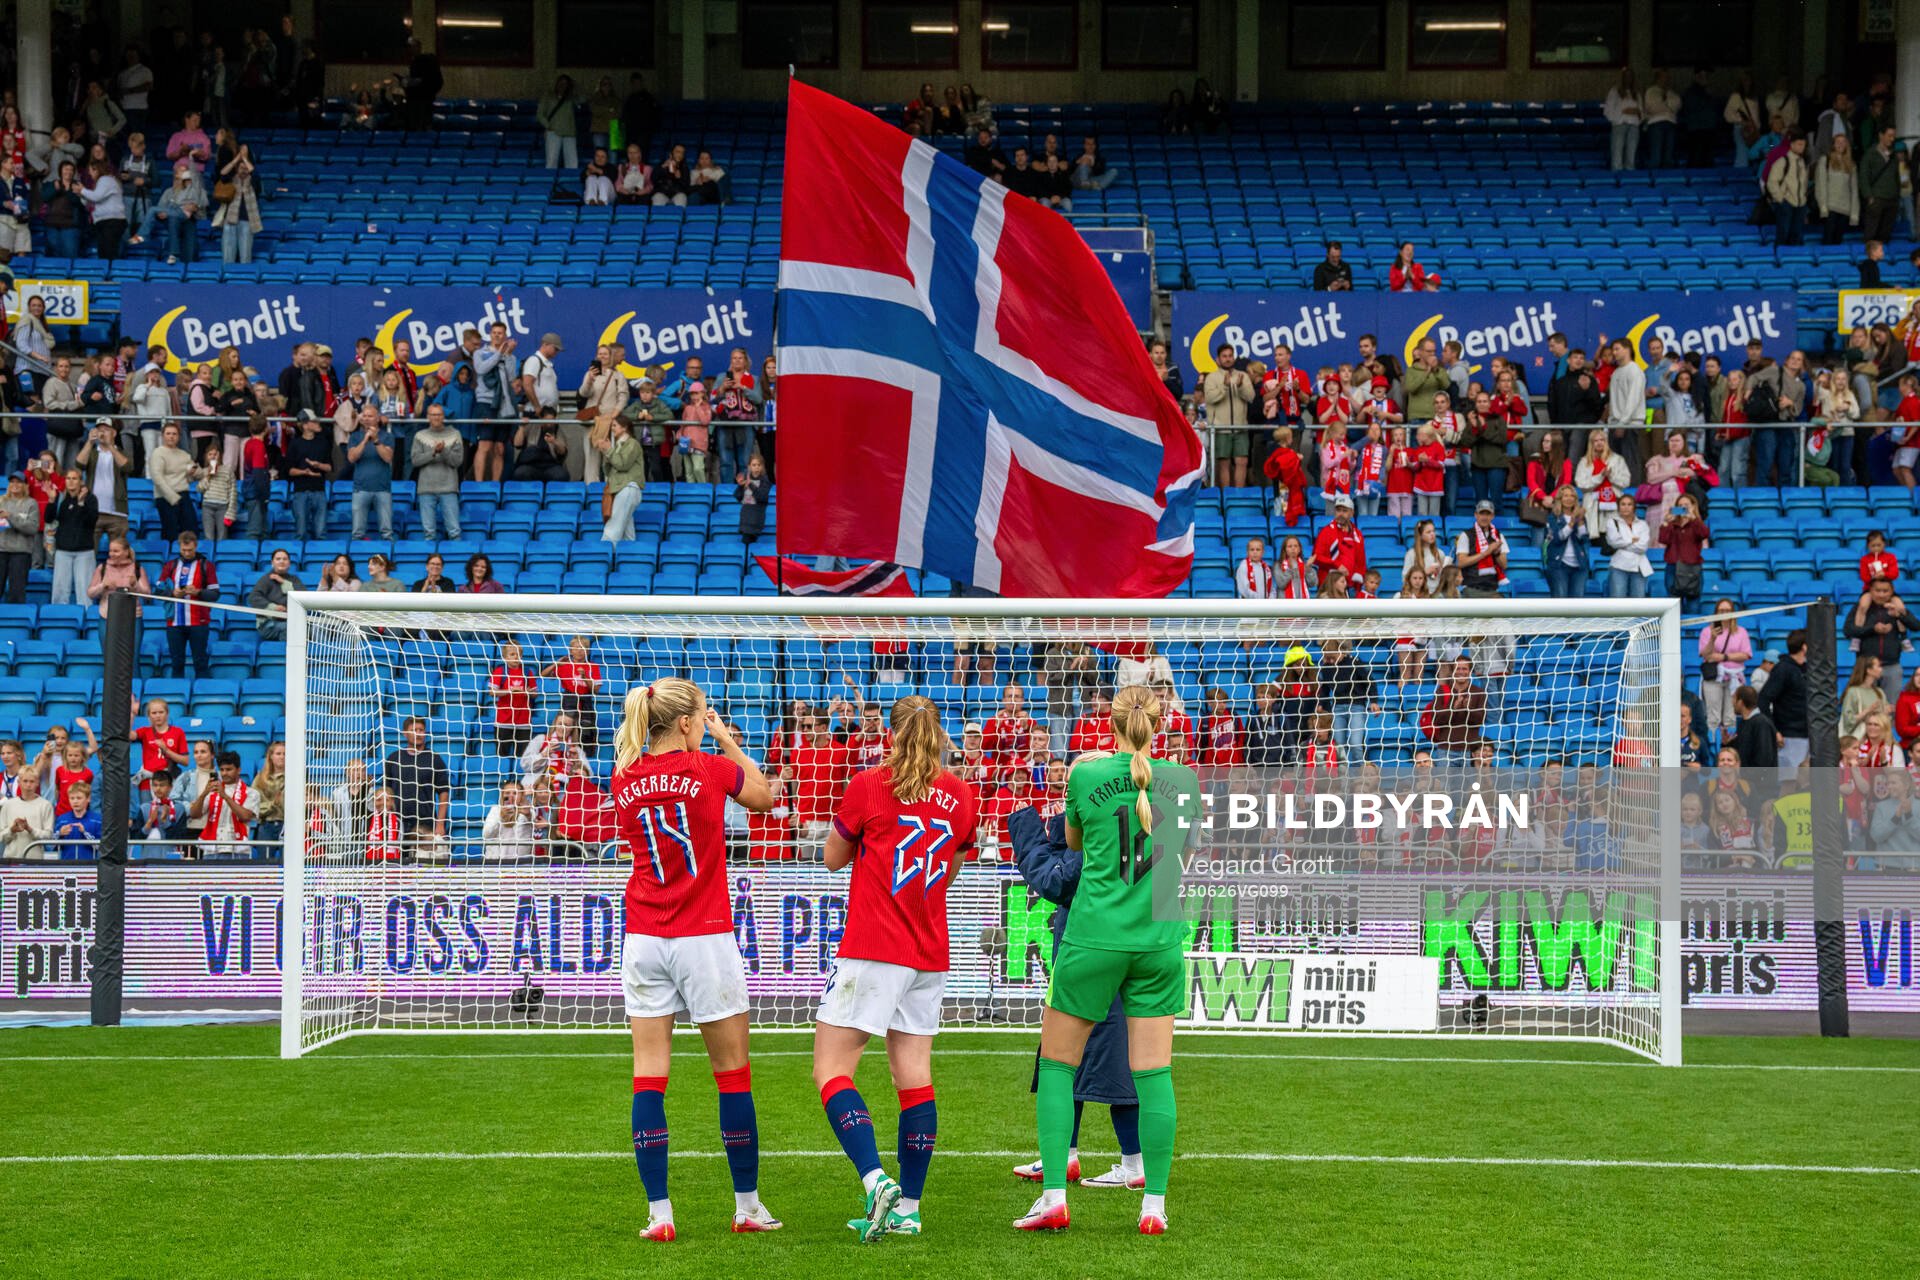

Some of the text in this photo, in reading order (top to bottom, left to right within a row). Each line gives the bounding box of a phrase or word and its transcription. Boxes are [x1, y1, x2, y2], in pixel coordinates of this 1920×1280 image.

[182, 295, 305, 356] Bendit
[631, 300, 753, 362] Bendit
[1224, 301, 1346, 360] Bendit
[617, 774, 702, 809] HEGERBERG
[636, 801, 698, 884] 14
[891, 814, 954, 900] 22
[17, 878, 98, 930] min
[200, 895, 252, 975] VI
[386, 895, 490, 974] OSS
[1424, 888, 1657, 988] KIWI
[1858, 907, 1913, 988] VI
[1303, 961, 1377, 992] mini
[1681, 940, 1777, 1005] pris
[1301, 993, 1366, 1030] pris
